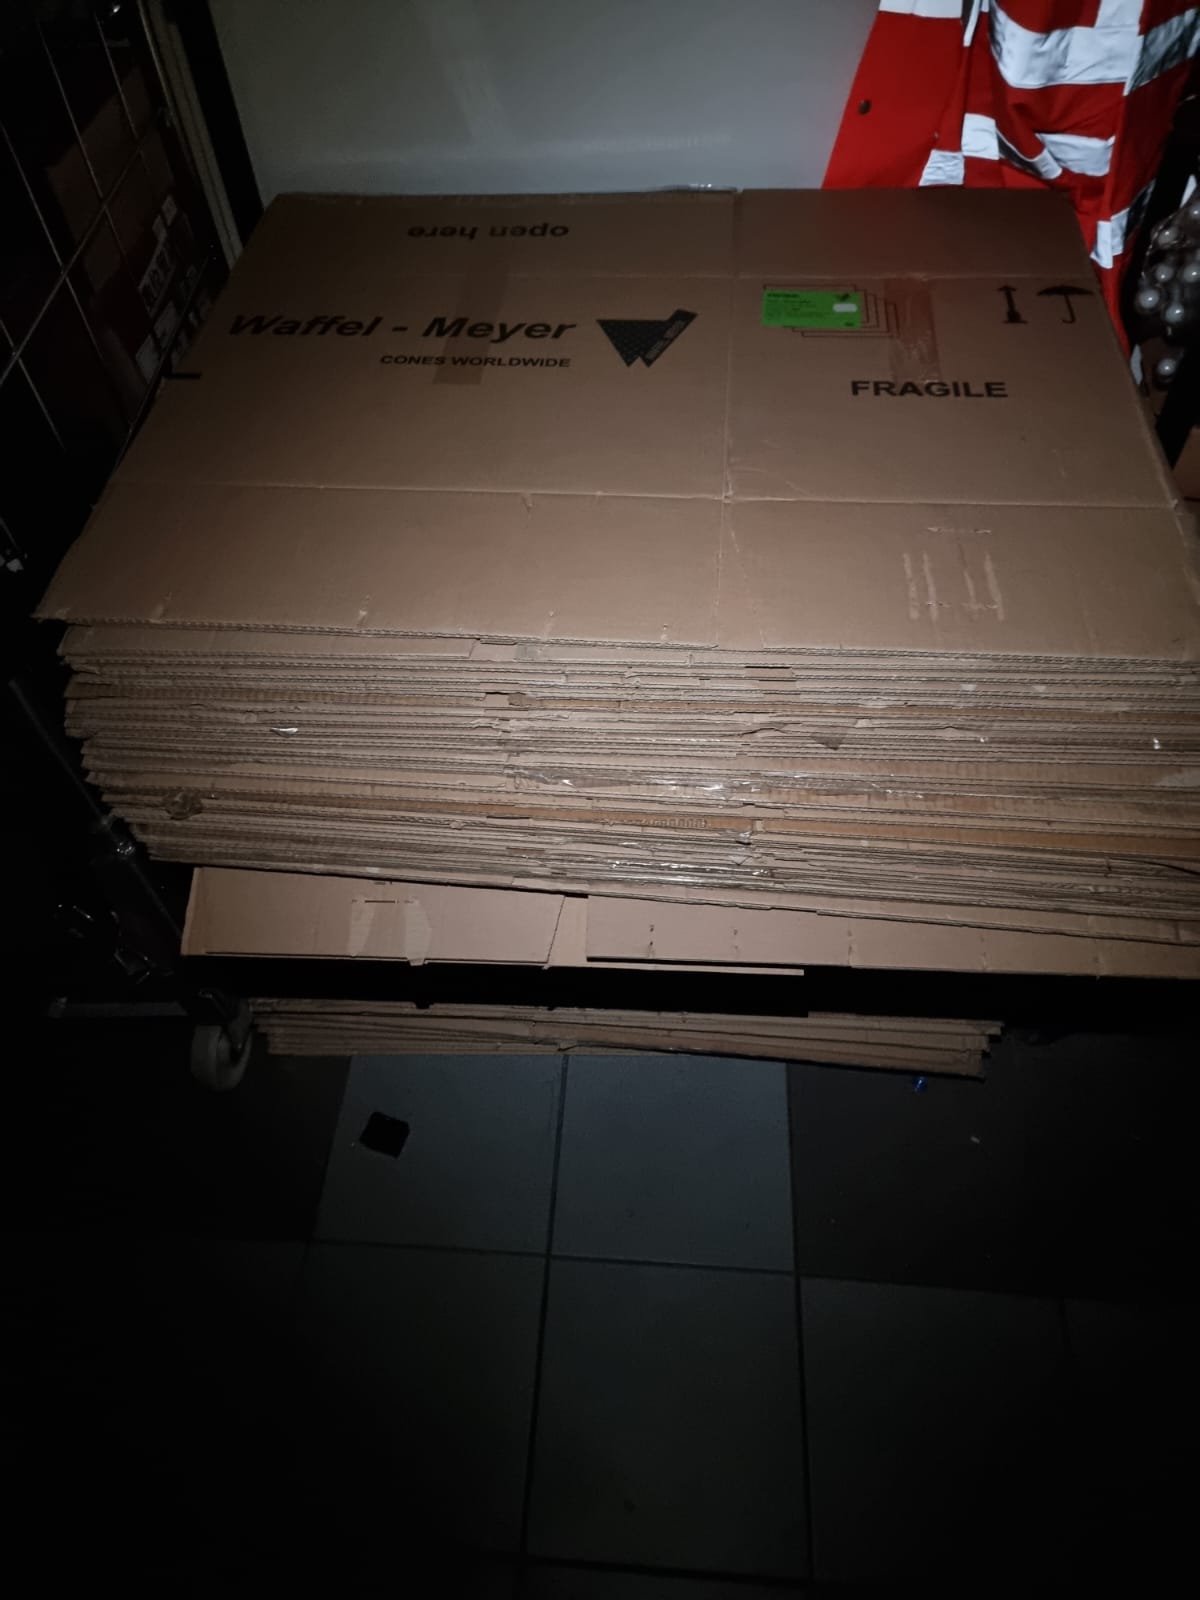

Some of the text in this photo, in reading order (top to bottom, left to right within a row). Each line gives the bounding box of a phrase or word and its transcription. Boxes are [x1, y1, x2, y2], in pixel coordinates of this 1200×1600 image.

[407, 222, 569, 239] open here
[229, 315, 383, 336] Waffel
[422, 317, 577, 343] Meyer
[380, 355, 571, 367] CONES WORLDWIDE
[851, 381, 1009, 398] FRAGILE
